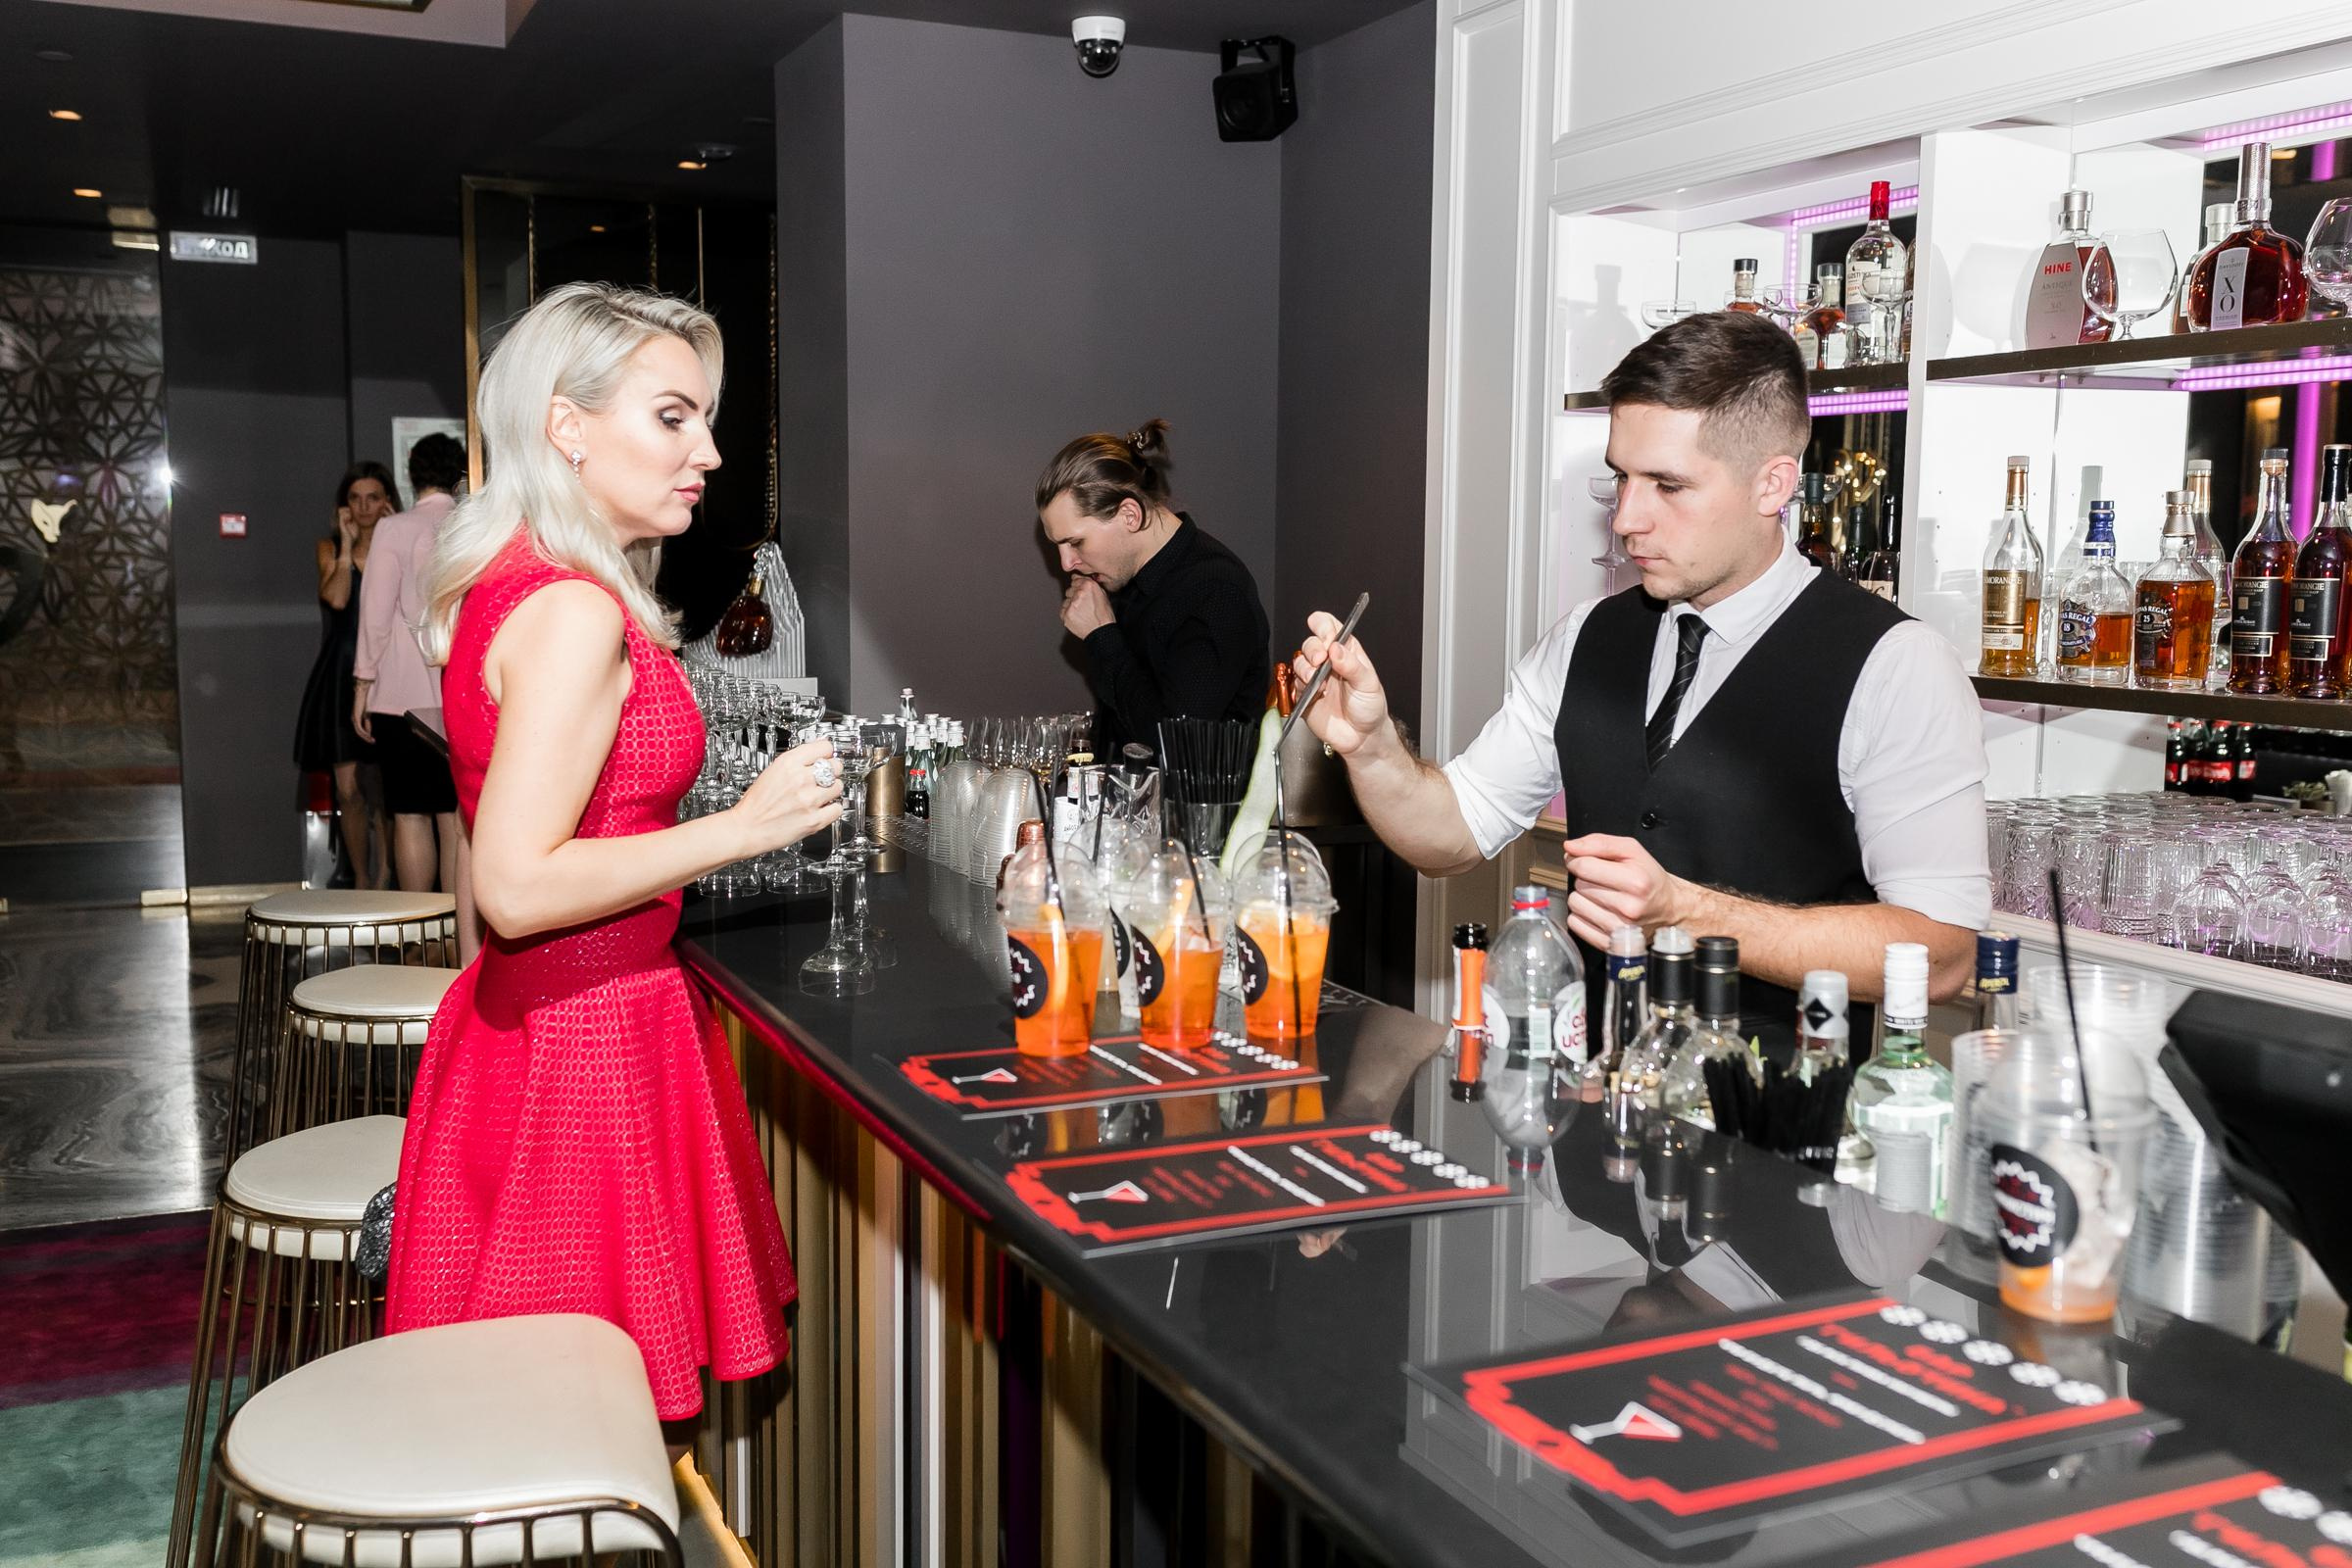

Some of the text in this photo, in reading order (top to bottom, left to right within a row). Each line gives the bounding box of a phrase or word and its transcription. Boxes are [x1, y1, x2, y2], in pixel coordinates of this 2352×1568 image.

[2044, 261, 2072, 274] HINE
[2148, 606, 2168, 615] REGAL
[2068, 612, 2091, 624] REGAL
[2063, 622, 2071, 632] 18
